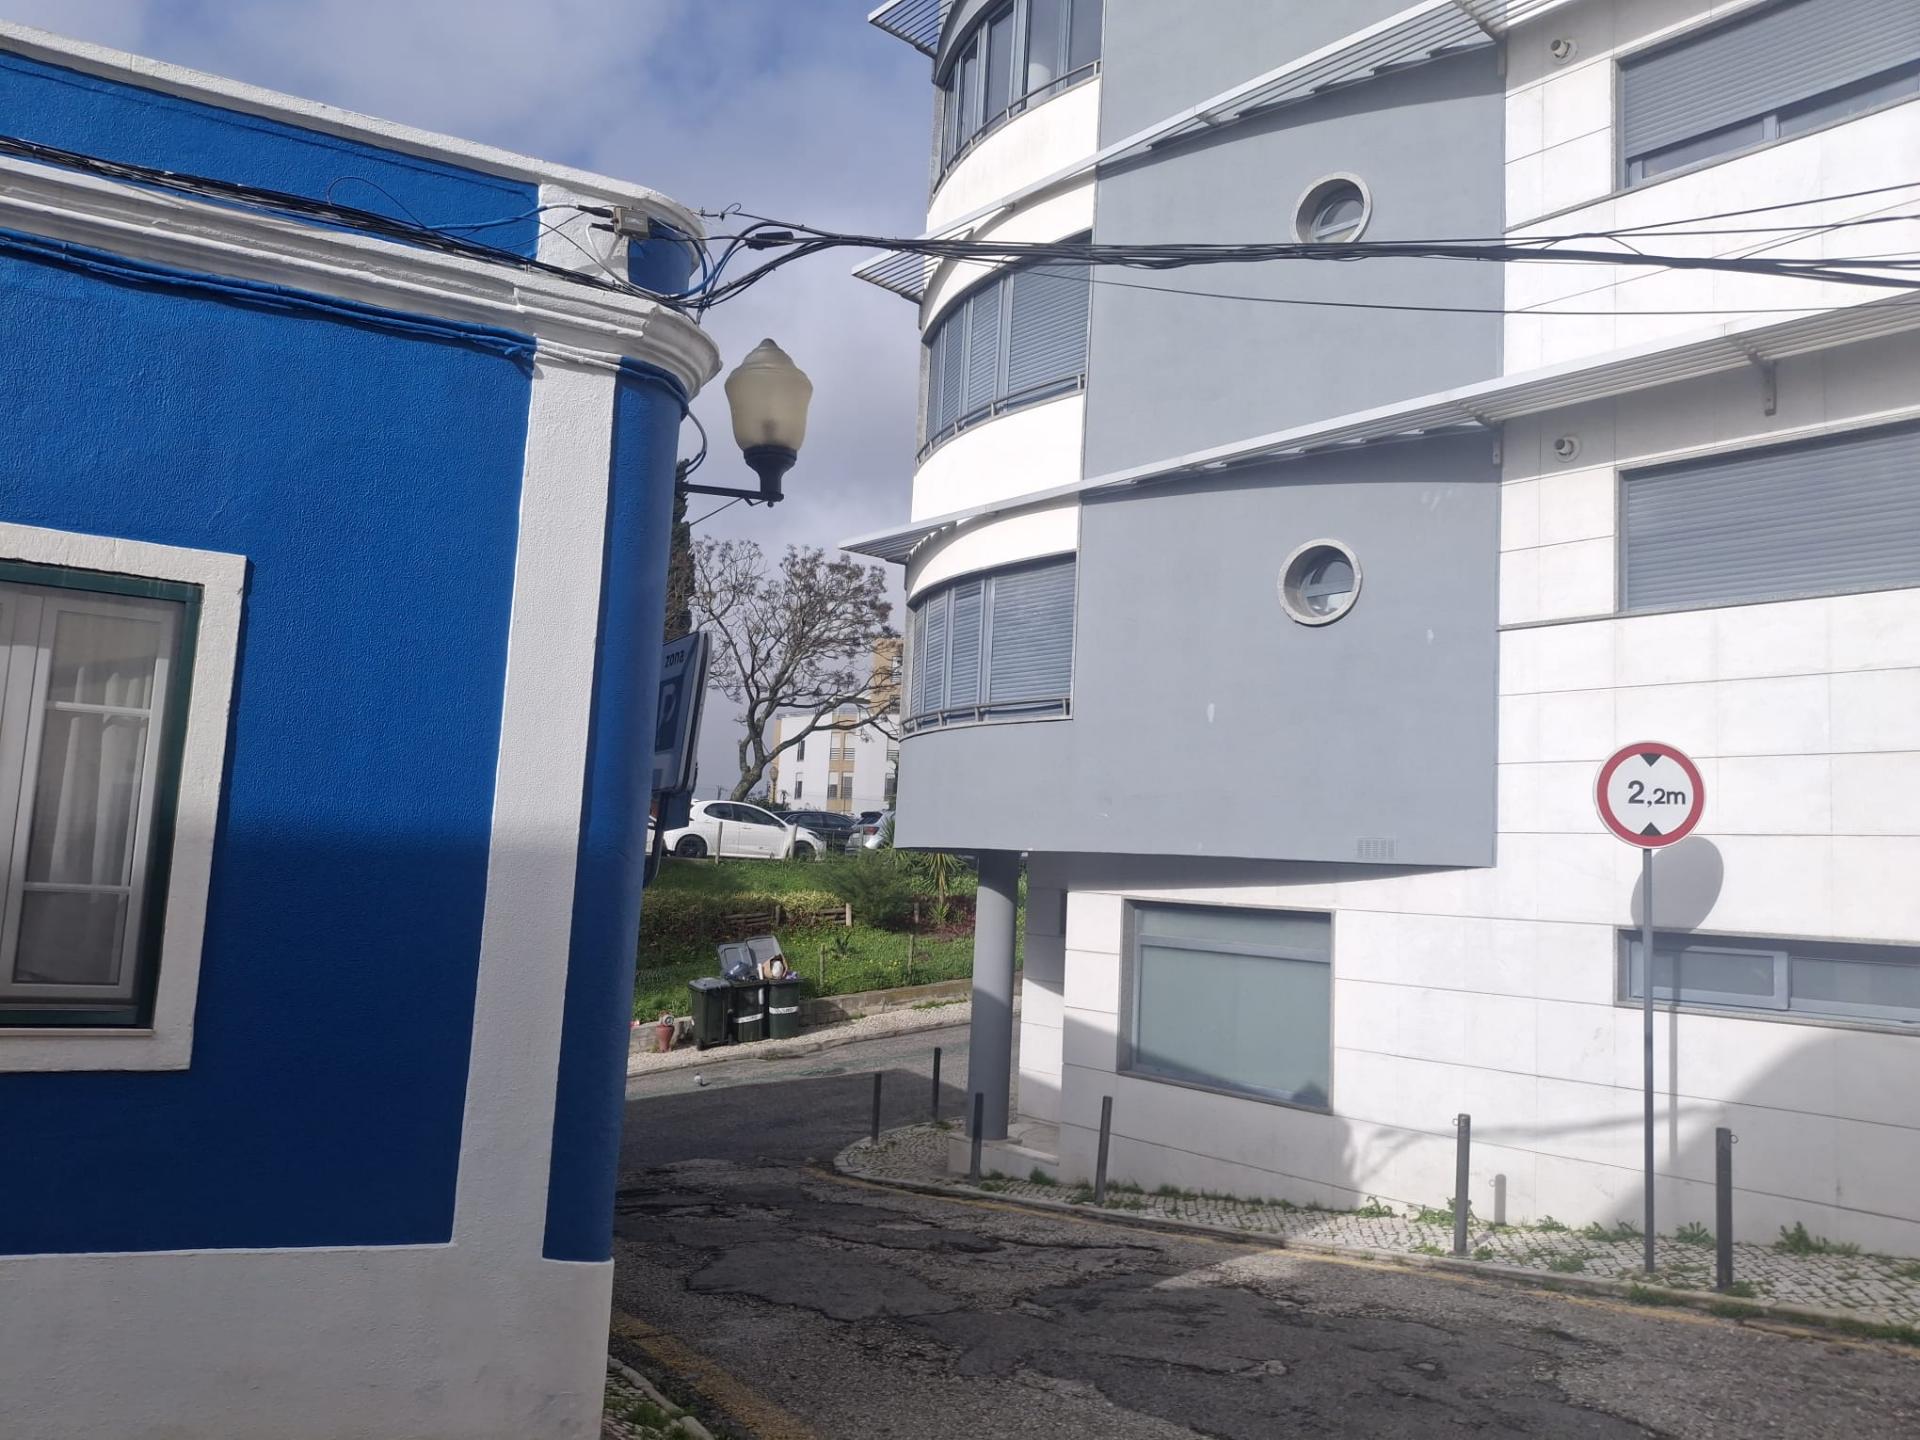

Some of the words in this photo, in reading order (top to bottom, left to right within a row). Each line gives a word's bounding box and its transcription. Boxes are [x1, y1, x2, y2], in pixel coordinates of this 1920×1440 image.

[664, 650, 685, 668] zona
[657, 683, 677, 738] P
[1627, 779, 1687, 807] 2,2m
